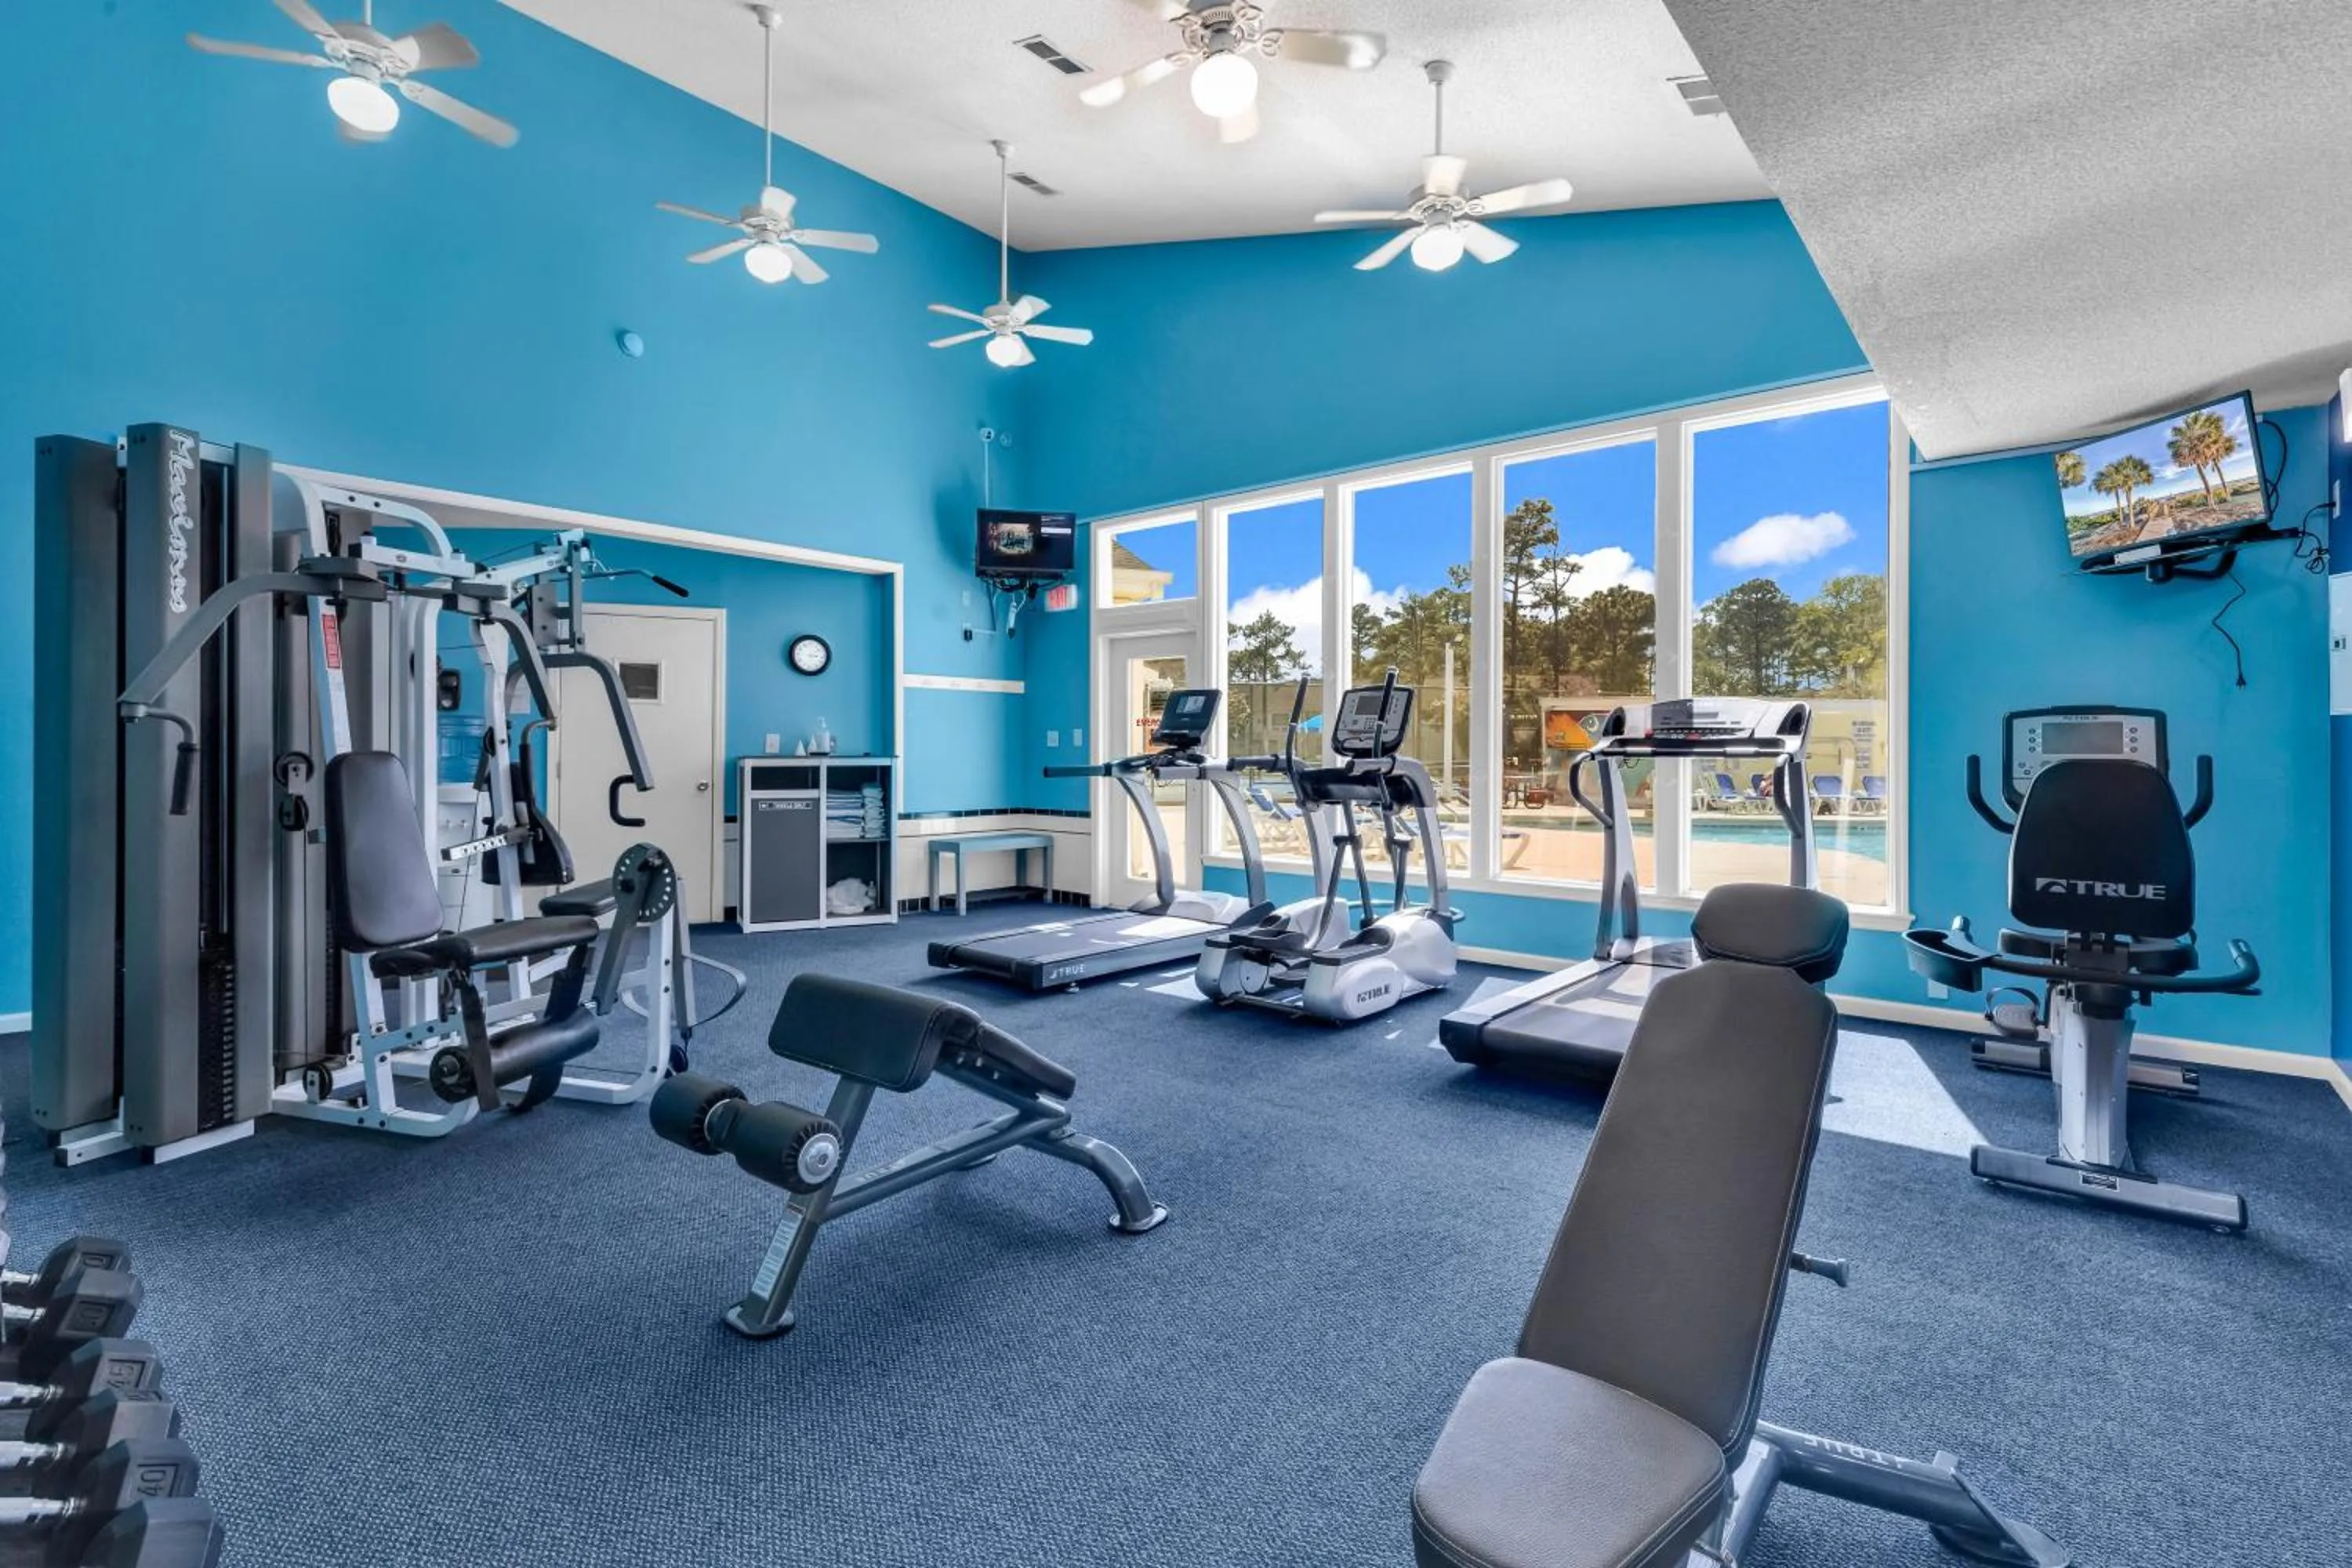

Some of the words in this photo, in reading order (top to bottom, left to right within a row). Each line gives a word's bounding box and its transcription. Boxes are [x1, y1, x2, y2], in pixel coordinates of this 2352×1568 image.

[2069, 880, 2166, 900] TRUE
[1058, 964, 1085, 978] TRUE
[136, 1469, 166, 1497] 40
